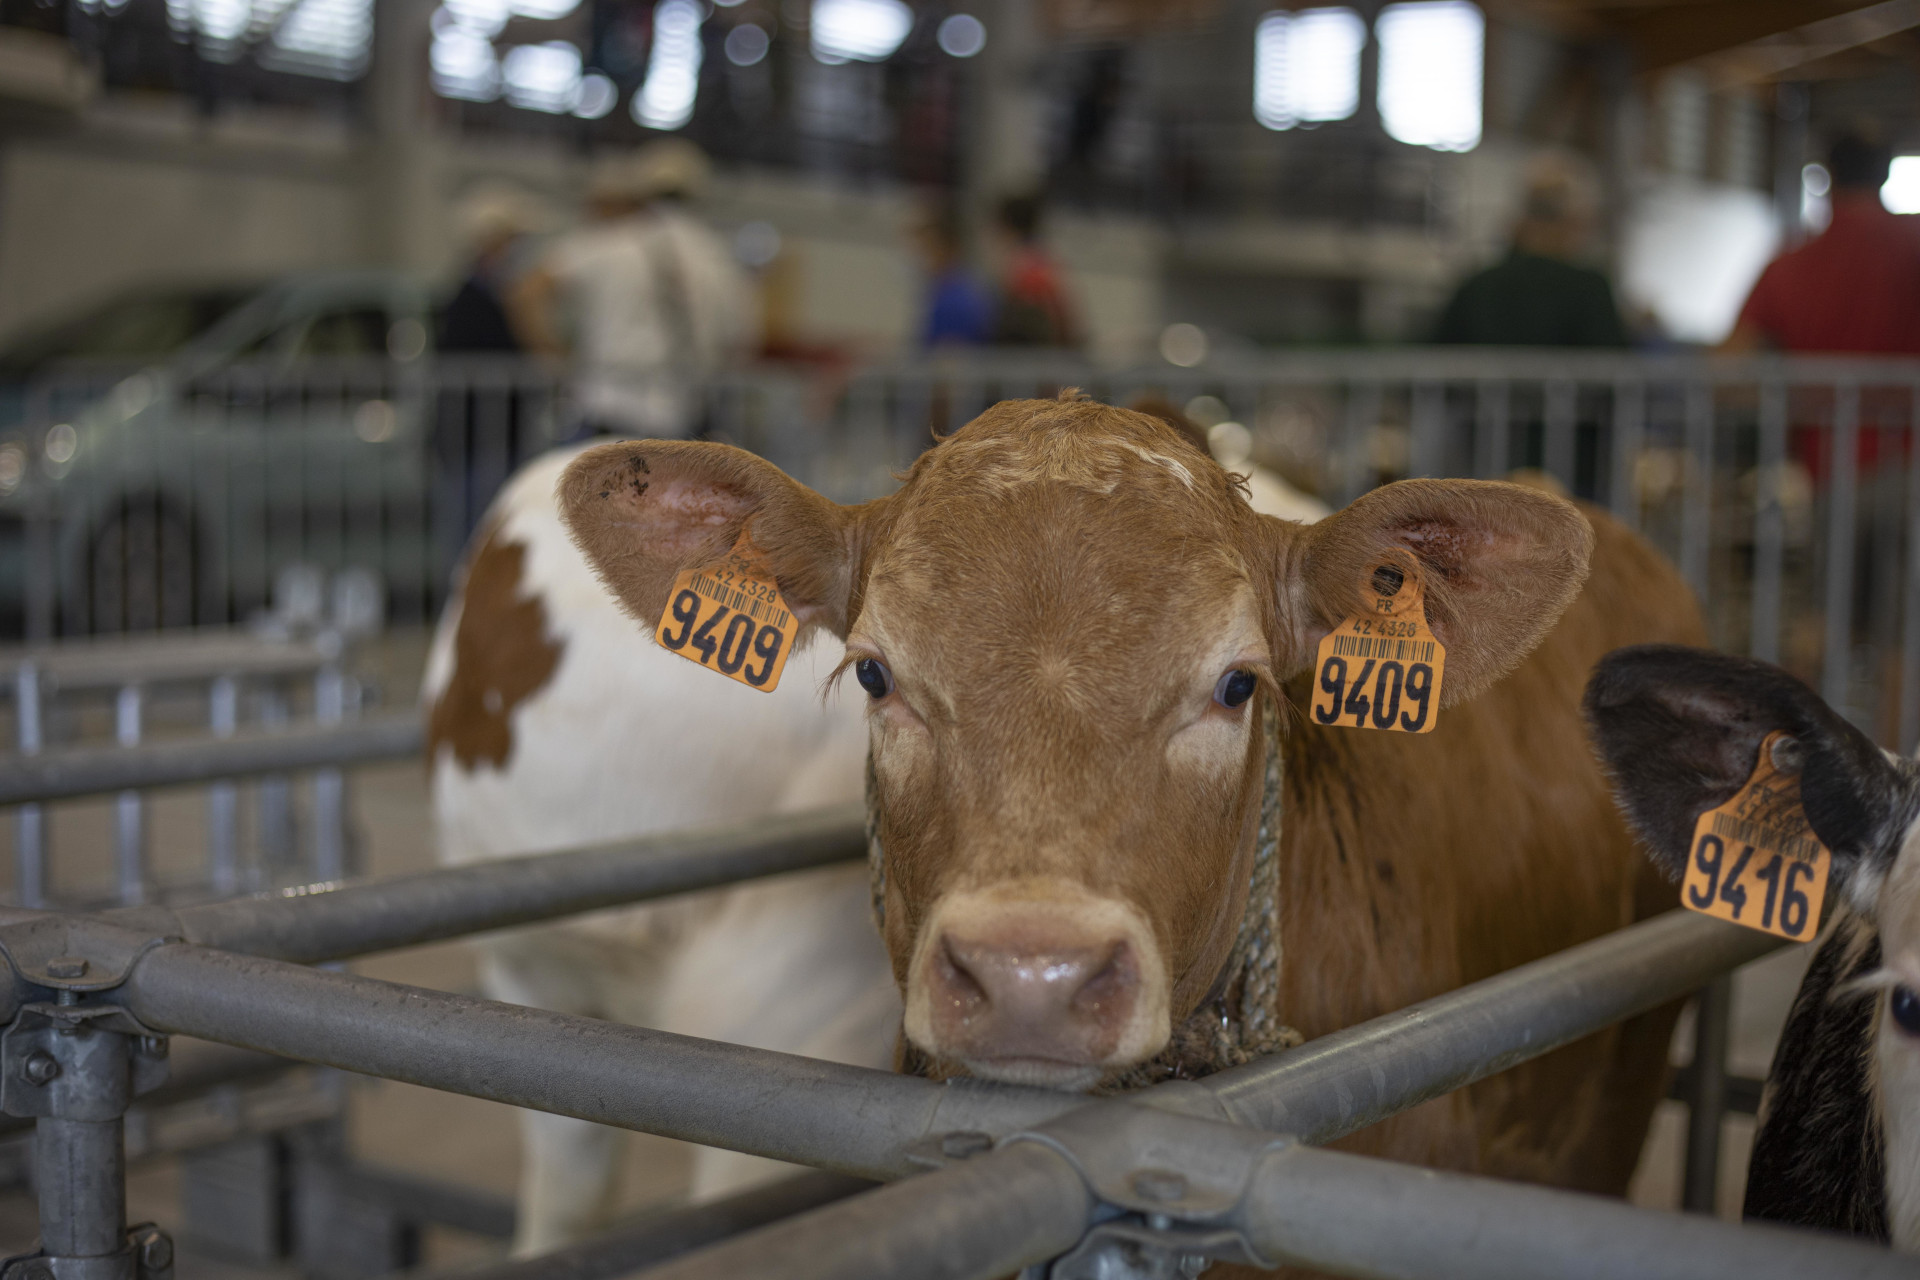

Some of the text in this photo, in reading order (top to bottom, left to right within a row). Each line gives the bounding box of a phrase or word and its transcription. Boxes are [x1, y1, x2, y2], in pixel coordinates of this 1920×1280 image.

[715, 569, 777, 603] 42 4328
[1376, 599, 1394, 613] FR
[662, 589, 784, 686] 9409
[1352, 619, 1417, 637] 42 4328
[1316, 656, 1434, 732] 9409
[1689, 834, 1815, 937] 9416
